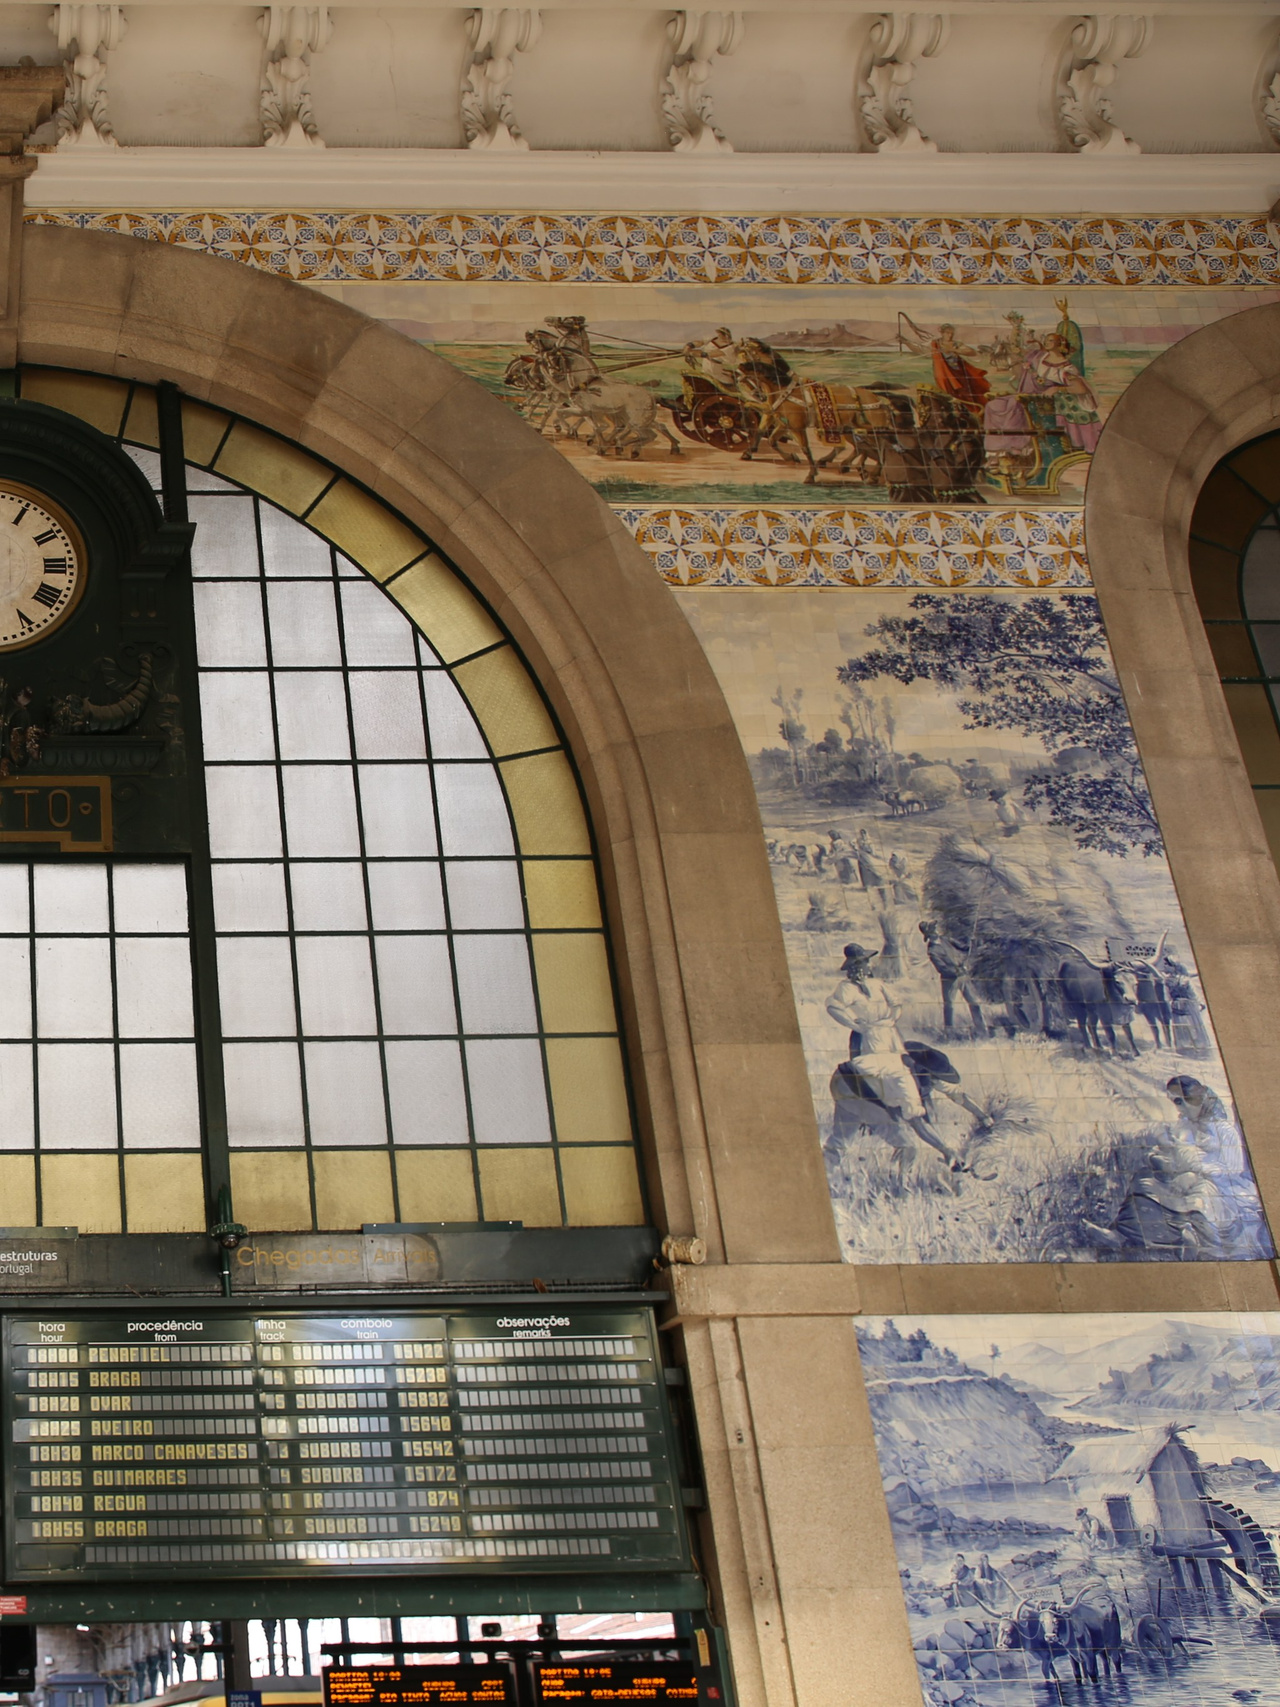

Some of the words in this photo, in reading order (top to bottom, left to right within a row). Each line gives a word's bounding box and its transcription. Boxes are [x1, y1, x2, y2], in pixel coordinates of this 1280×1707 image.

[11, 506, 30, 526] I
[32, 528, 58, 547] II
[42, 556, 68, 575] III
[16, 608, 35, 629] V
[236, 1246, 360, 1270] Chegadas
[374, 1247, 437, 1264] Arrivals
[38, 1322, 66, 1332] hora
[128, 1320, 203, 1332] procedência
[258, 1319, 286, 1330] linha
[340, 1319, 392, 1328] comboio
[496, 1316, 570, 1328] observações
[41, 1333, 63, 1342] hour
[154, 1332, 176, 1342] from
[260, 1332, 285, 1340] track
[357, 1330, 378, 1339] train
[513, 1328, 551, 1338] remarks
[89, 1347, 170, 1362] PENAFIEL
[90, 1372, 140, 1386] BRAGA
[29, 1396, 80, 1412] 18H20
[90, 1396, 131, 1411] OVAR
[276, 1394, 285, 1409] 5
[91, 1420, 153, 1436] AVEIRO
[30, 1446, 82, 1462] 18H30
[92, 1445, 144, 1461] MARCO
[154, 1444, 248, 1460] CANAVESES
[279, 1443, 288, 1458] 3
[300, 1442, 360, 1458] SUBURB
[402, 1440, 454, 1456] 15542
[30, 1470, 82, 1486] 18H35
[93, 1469, 186, 1486] GUIMARAES
[280, 1468, 290, 1484] 4
[302, 1467, 362, 1483] SUBURB
[405, 1466, 456, 1482] 15172
[31, 1496, 83, 1512] 18H40
[94, 1495, 146, 1511] REGUA
[282, 1493, 292, 1508] 1
[428, 1490, 459, 1506] 874
[32, 1521, 84, 1537] 18H55
[95, 1520, 147, 1536] BRAGA
[284, 1518, 294, 1534] 2
[305, 1518, 367, 1534] SUBURB
